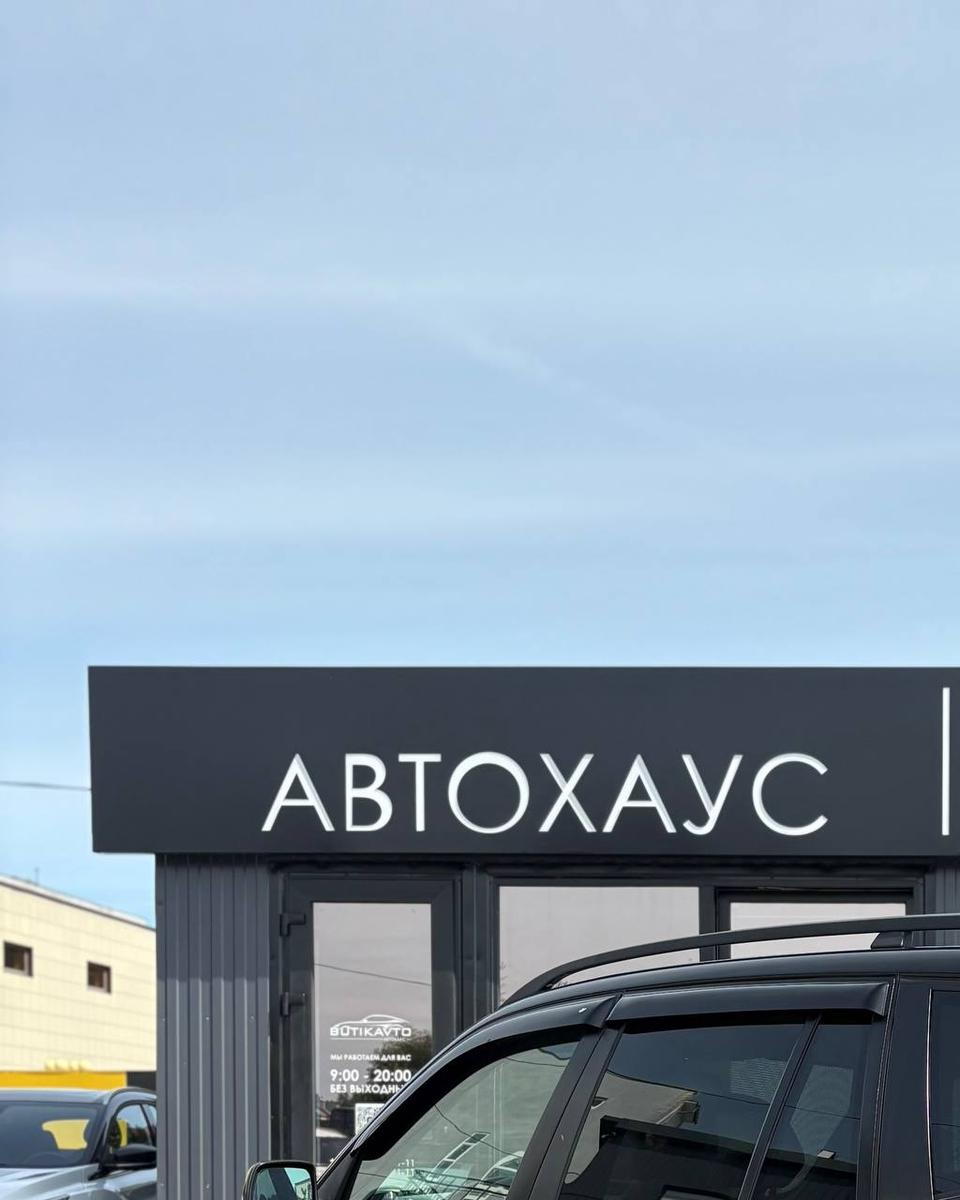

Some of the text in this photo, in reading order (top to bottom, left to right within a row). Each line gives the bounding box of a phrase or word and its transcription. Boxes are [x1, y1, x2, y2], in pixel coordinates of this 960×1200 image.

[261, 750, 828, 836] АВТОХАУС
[330, 1027, 412, 1037] BUTIKAVTO
[380, 1054, 396, 1062] ДЛЯ
[330, 1069, 360, 1082] 9:00
[373, 1069, 412, 1082] 20:00
[330, 1084, 405, 1095] БЕЗ ВЫХОДН
